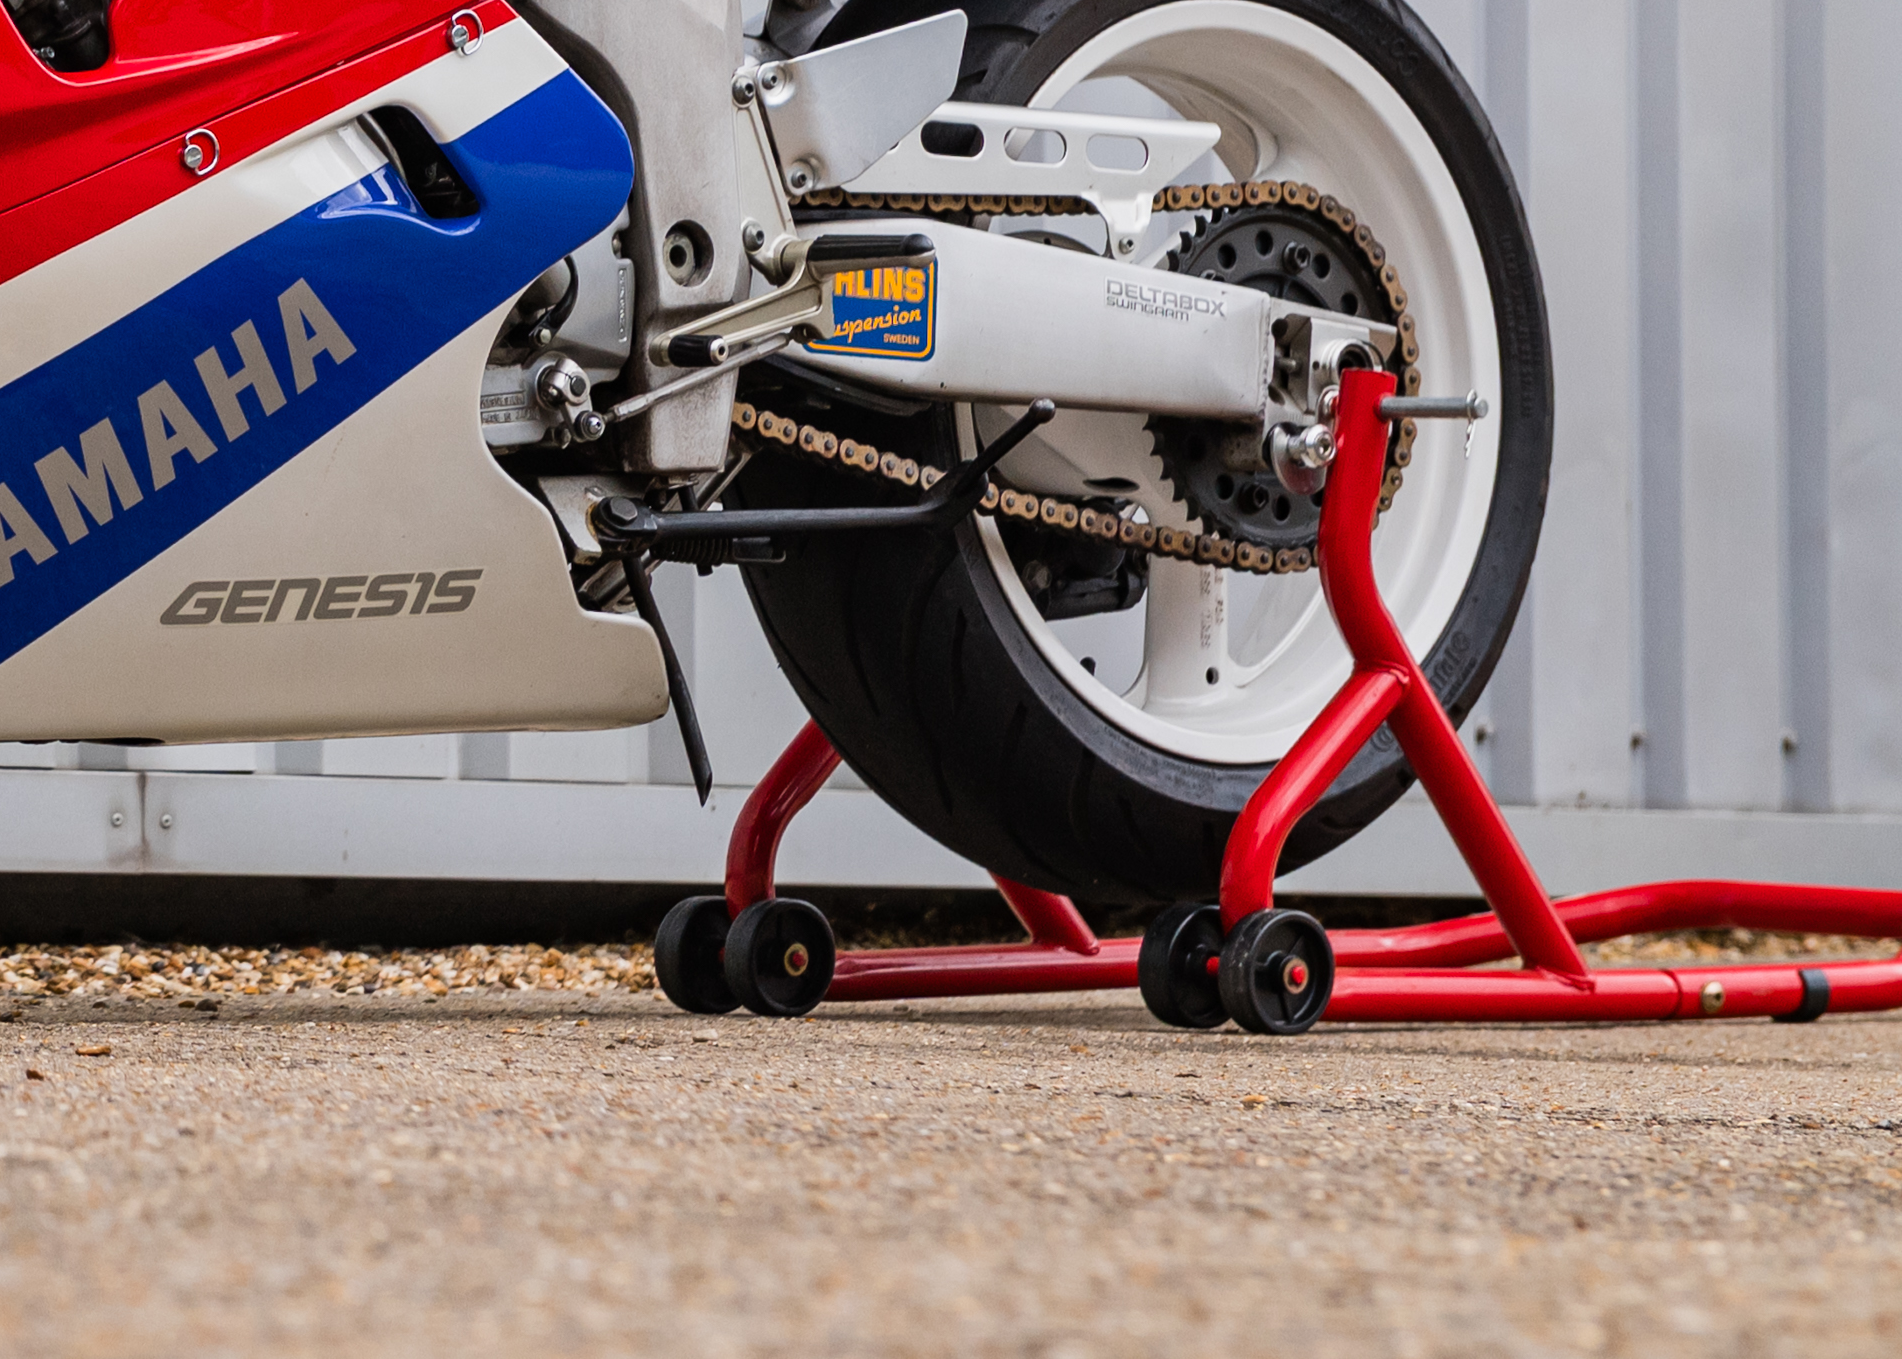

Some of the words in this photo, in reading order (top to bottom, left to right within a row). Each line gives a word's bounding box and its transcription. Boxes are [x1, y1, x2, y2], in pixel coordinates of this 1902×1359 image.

[834, 267, 925, 302] HLINS
[1106, 279, 1225, 317] DELTABOX
[834, 305, 921, 343] uspension
[1106, 295, 1189, 321] SWINGARM
[883, 333, 919, 345] SWEDEN
[159, 569, 484, 626] GENESIS
